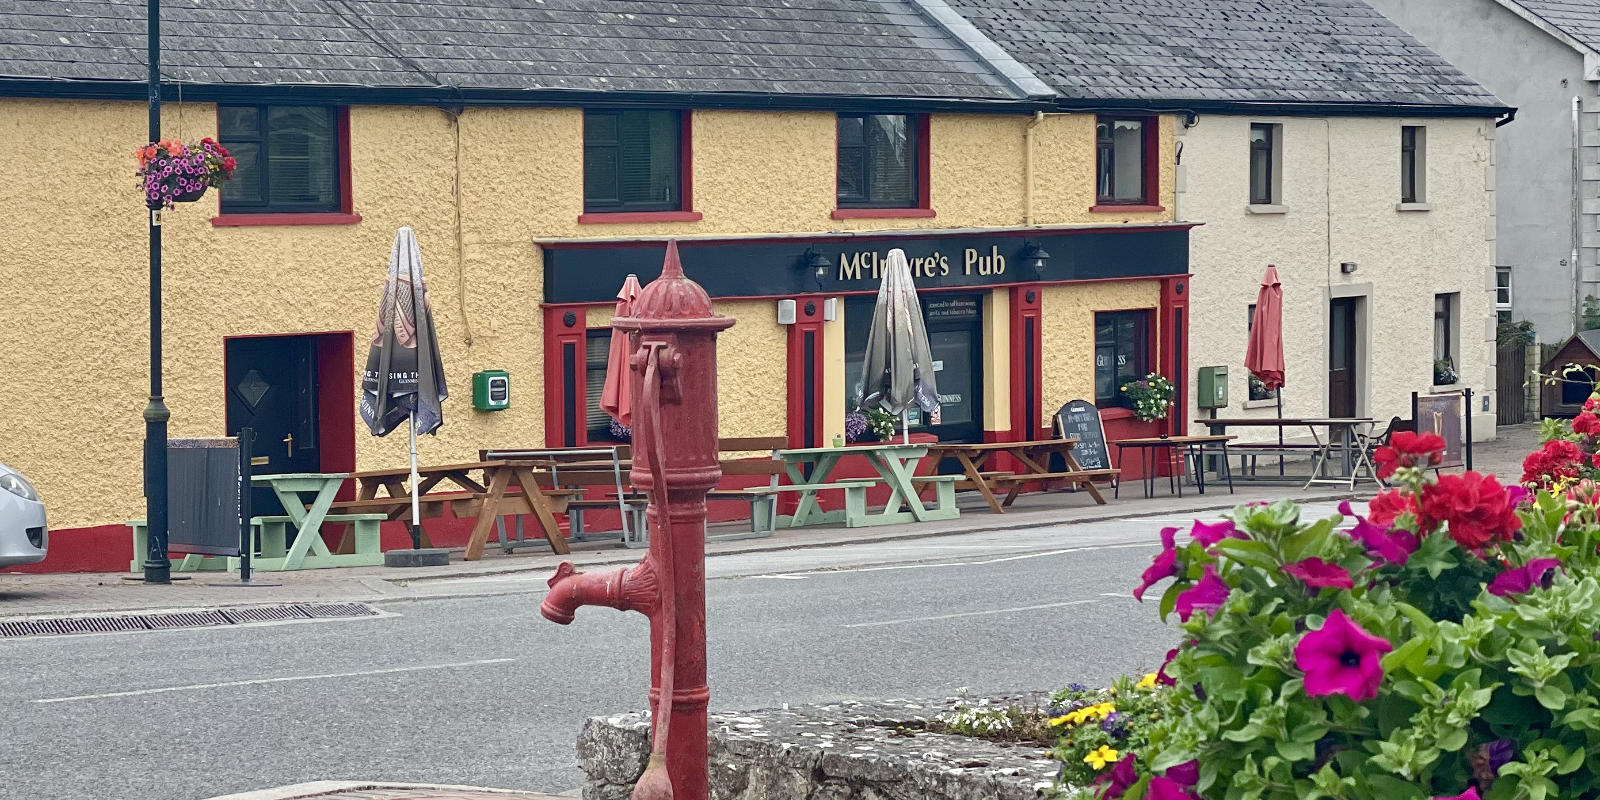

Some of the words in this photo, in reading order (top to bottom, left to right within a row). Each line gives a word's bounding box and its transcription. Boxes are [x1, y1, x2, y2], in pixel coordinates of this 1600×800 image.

[838, 251, 950, 281] McInre's
[964, 245, 1006, 276] Pub
[389, 372, 408, 380] SING
